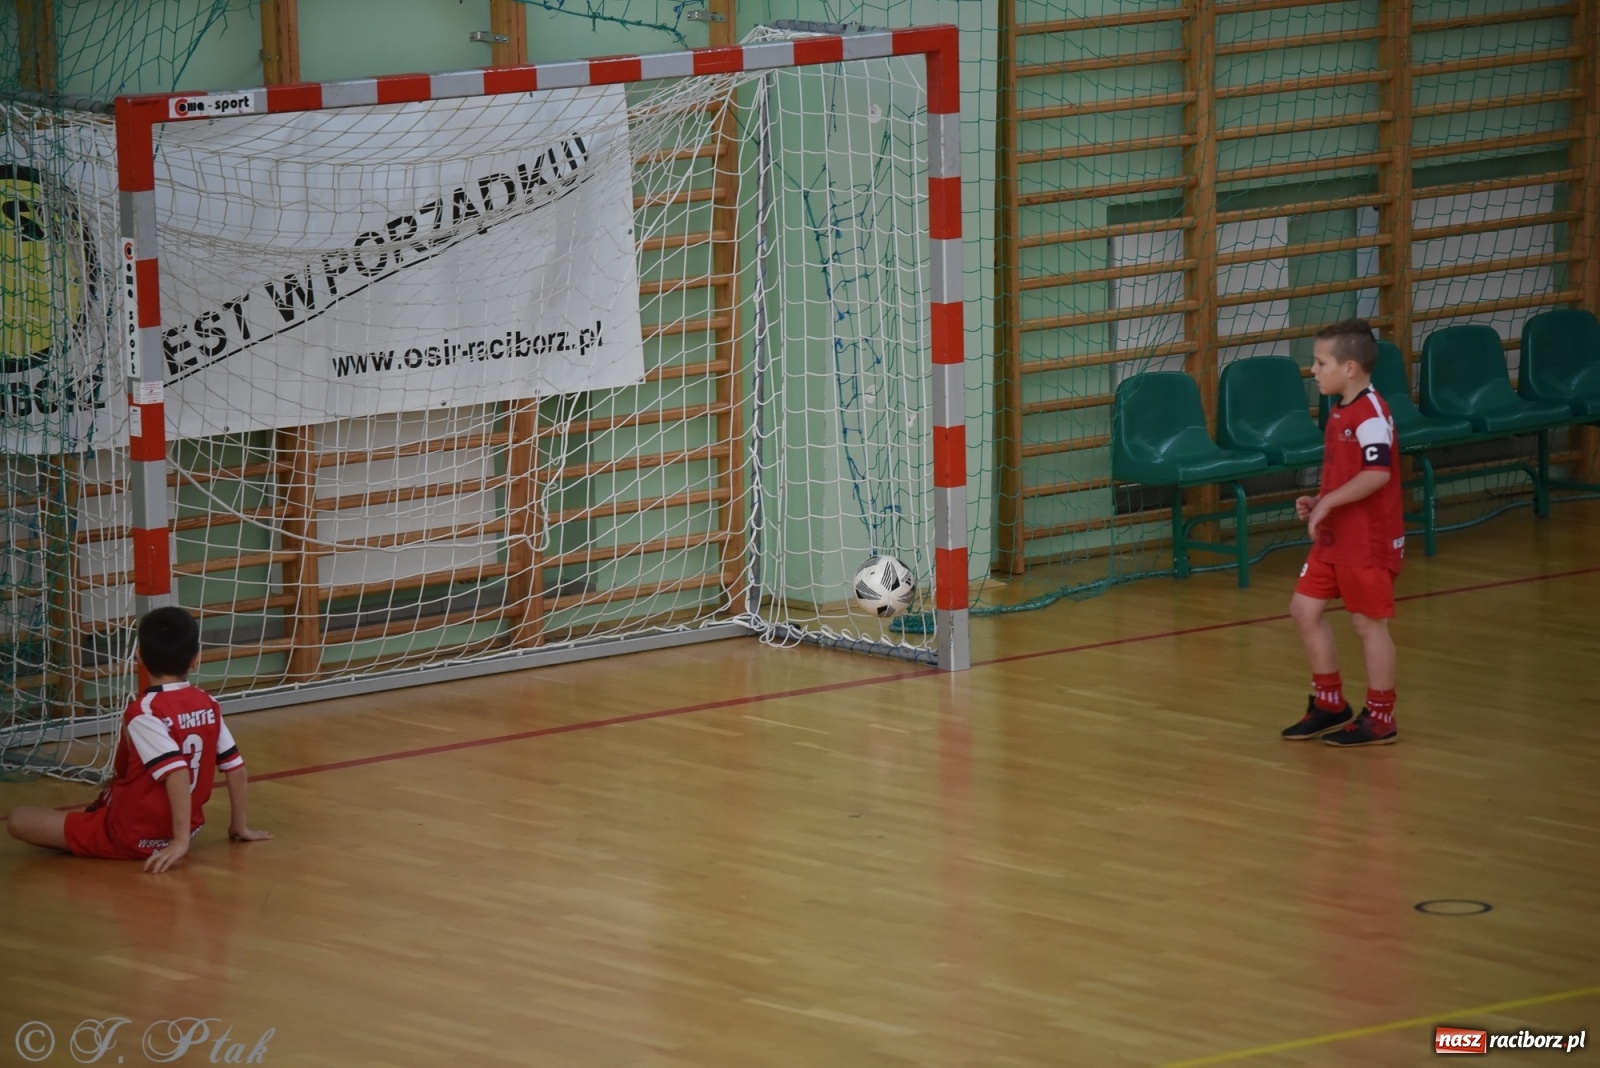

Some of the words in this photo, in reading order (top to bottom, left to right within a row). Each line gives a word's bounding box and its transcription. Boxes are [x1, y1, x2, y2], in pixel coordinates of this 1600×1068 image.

[215, 96, 250, 112] sport
[162, 293, 250, 376] EST
[1365, 446, 1379, 461] C
